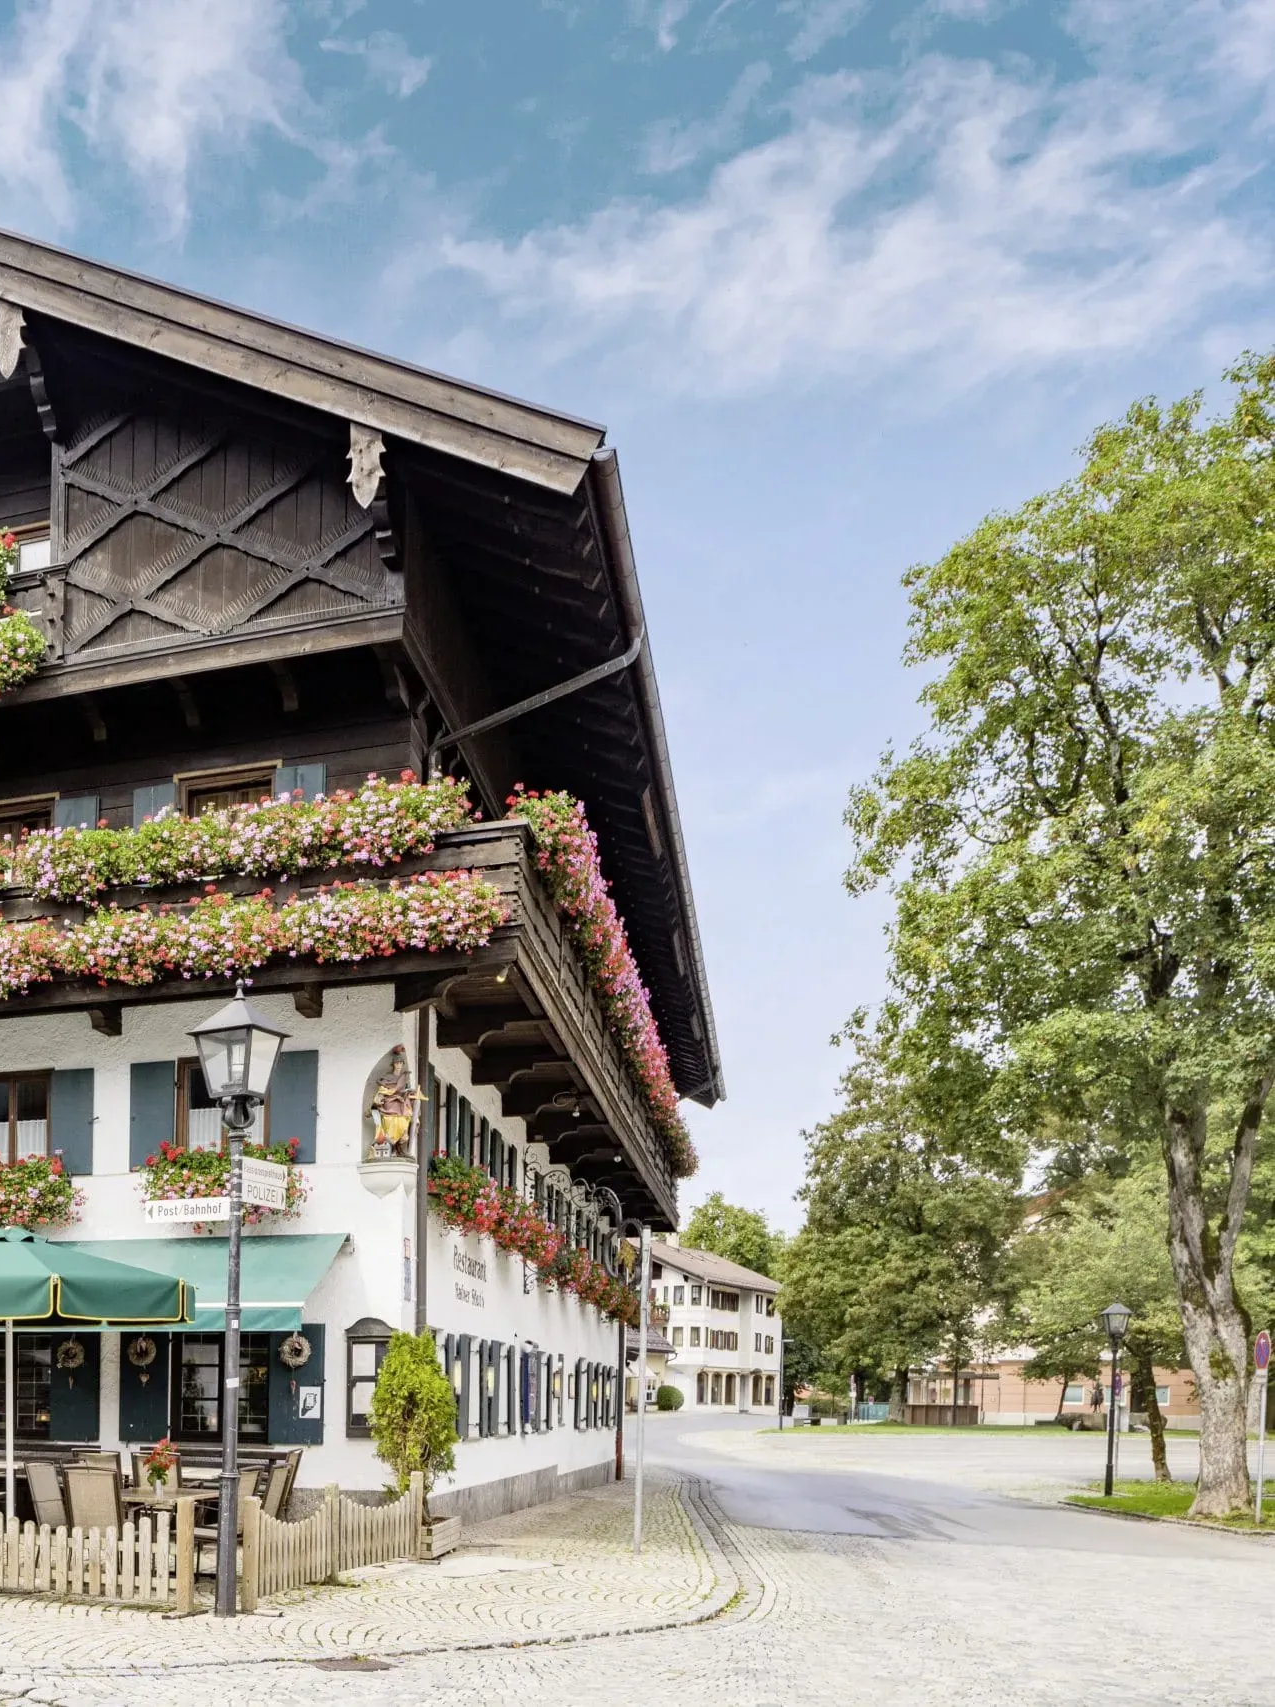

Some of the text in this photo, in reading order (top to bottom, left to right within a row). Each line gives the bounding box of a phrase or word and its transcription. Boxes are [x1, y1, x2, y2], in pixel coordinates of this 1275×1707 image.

[247, 1184, 278, 1204] POLIZEI
[157, 1202, 222, 1217] Post/Bahnhof
[453, 1244, 487, 1282] Restaurant
